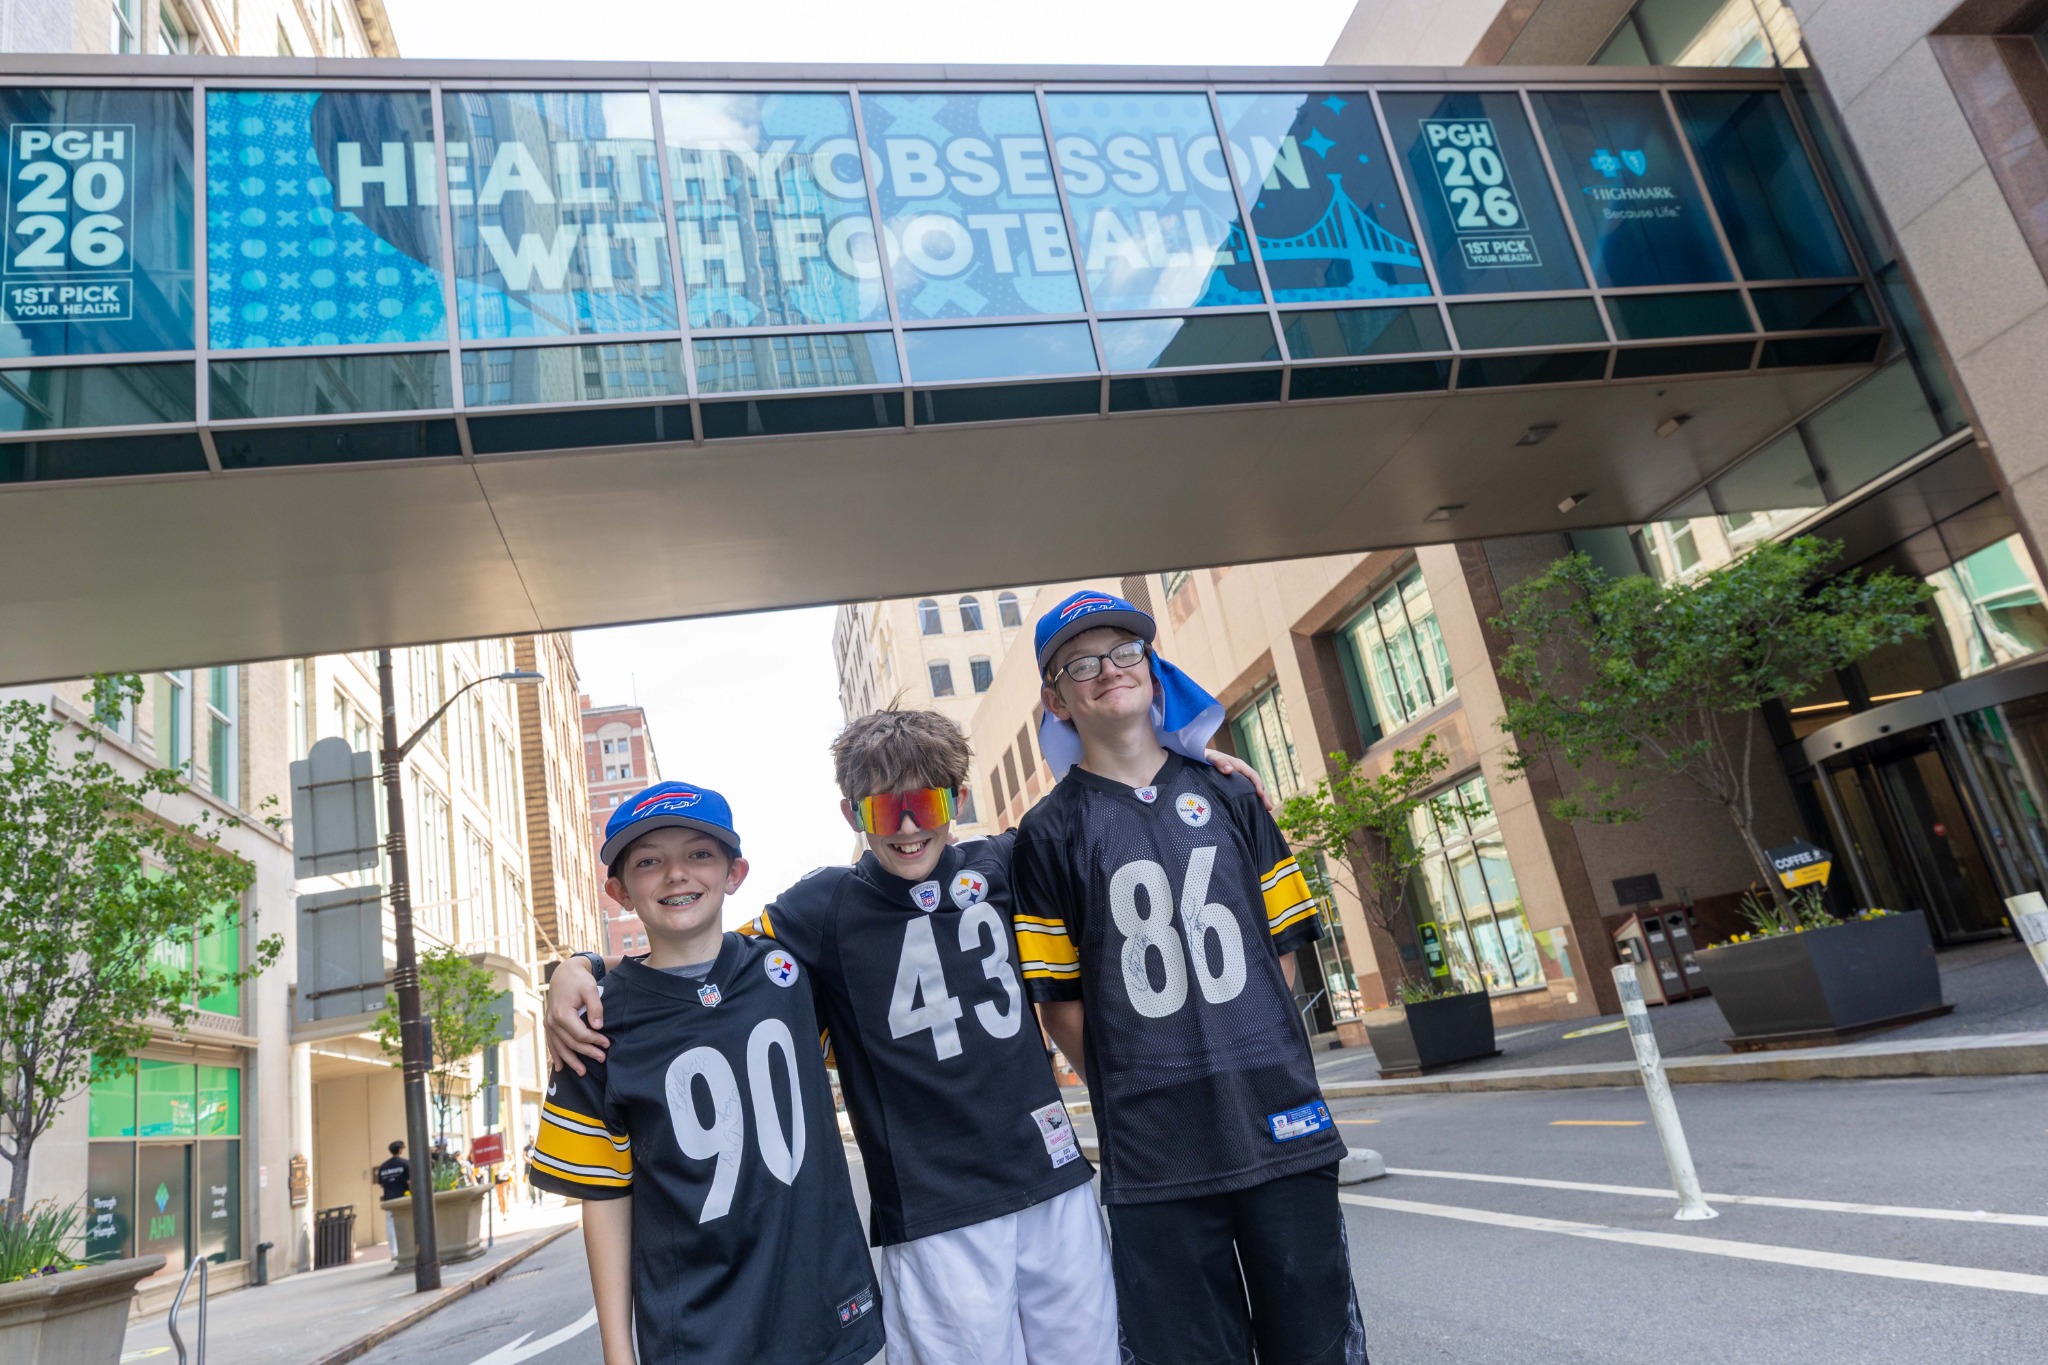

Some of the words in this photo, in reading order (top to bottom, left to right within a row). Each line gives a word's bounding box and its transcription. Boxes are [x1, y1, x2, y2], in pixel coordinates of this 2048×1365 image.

[19, 130, 125, 160] PGH
[1426, 123, 1493, 147] PGH
[337, 139, 797, 207] HEALTHY
[811, 135, 1310, 199] OBSESSION
[1436, 147, 1504, 186] 20
[16, 161, 125, 213] 20
[1592, 186, 1676, 201] HIGHMARK
[1450, 187, 1519, 228] 26
[14, 214, 125, 268] 26
[479, 219, 747, 290] WITH
[774, 209, 1236, 281] FOOTBALL
[1465, 242, 1490, 254] 1ST
[1492, 241, 1529, 254] PICK
[1471, 254, 1498, 263] YOUR
[1498, 253, 1533, 262] HEALTH
[11, 287, 54, 304] 1ST
[59, 285, 119, 303] PICK
[15, 304, 58, 316] YOUR
[63, 303, 120, 315] HEALTH
[1774, 851, 1813, 870] COFFEE
[1109, 846, 1248, 1019] 86
[153, 935, 186, 970] AHN
[703, 992, 719, 1004] NFL
[888, 901, 1022, 1062] 43
[664, 1018, 806, 1224] 90
[149, 1214, 176, 1242] AHN
